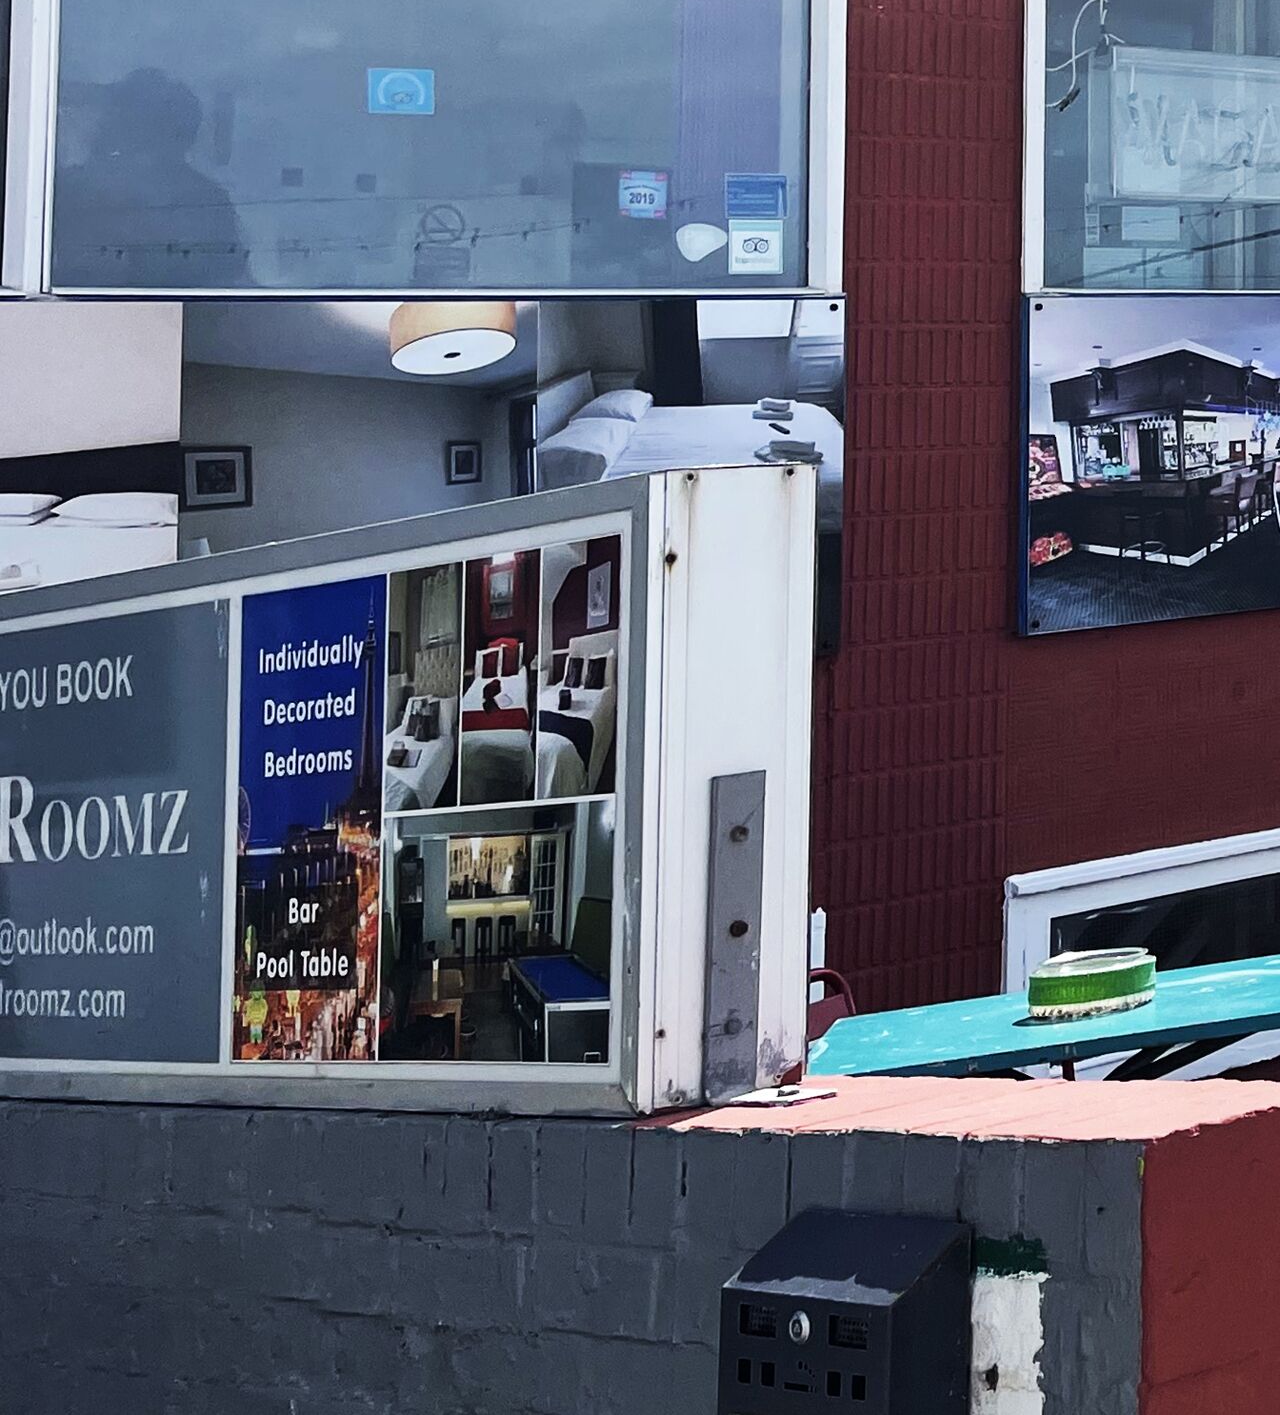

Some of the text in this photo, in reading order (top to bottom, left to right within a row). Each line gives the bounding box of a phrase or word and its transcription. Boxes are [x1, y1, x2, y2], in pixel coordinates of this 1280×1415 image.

[628, 192, 655, 205] 2019
[259, 634, 364, 674] Individually
[0, 655, 133, 711] YOU BOOK
[263, 688, 355, 726] Decorated
[264, 749, 353, 778] Bedrooms
[288, 897, 319, 924] Bar
[256, 947, 349, 979] Pool Table
[0, 979, 126, 1018] roomz.com
